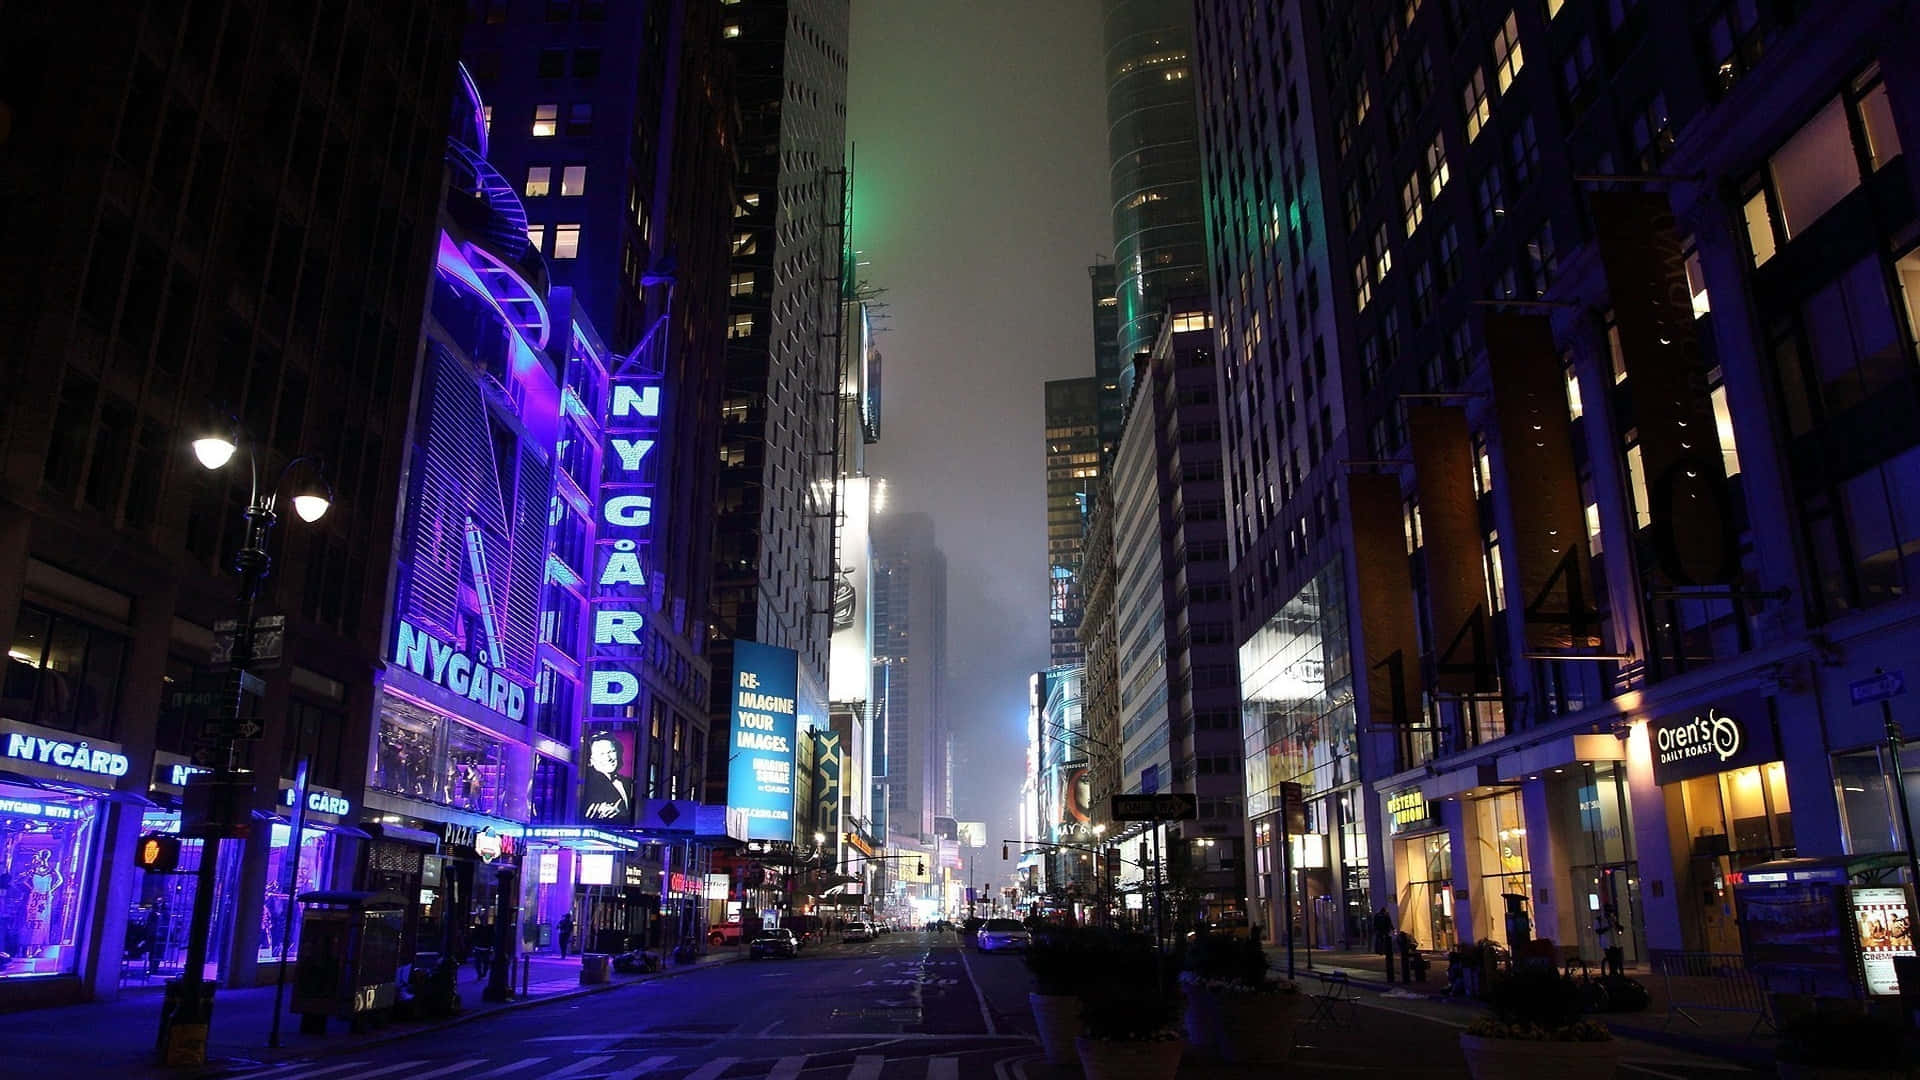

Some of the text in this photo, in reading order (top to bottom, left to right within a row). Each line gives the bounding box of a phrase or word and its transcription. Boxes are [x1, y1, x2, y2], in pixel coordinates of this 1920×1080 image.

[590, 385, 660, 705] NYGÅRD
[396, 620, 525, 722] NYGÅRD
[739, 671, 760, 689] RE-
[739, 691, 794, 715] IMAGINE
[737, 710, 774, 731] YOUR
[737, 731, 790, 753] IMAGES.
[1658, 717, 1711, 751] Oren's
[7, 733, 128, 777] NYGÅRD
[1660, 743, 1712, 764] DAILY ROAST
[287, 788, 349, 816] NGÅRD
[445, 822, 474, 847] PIZZA
